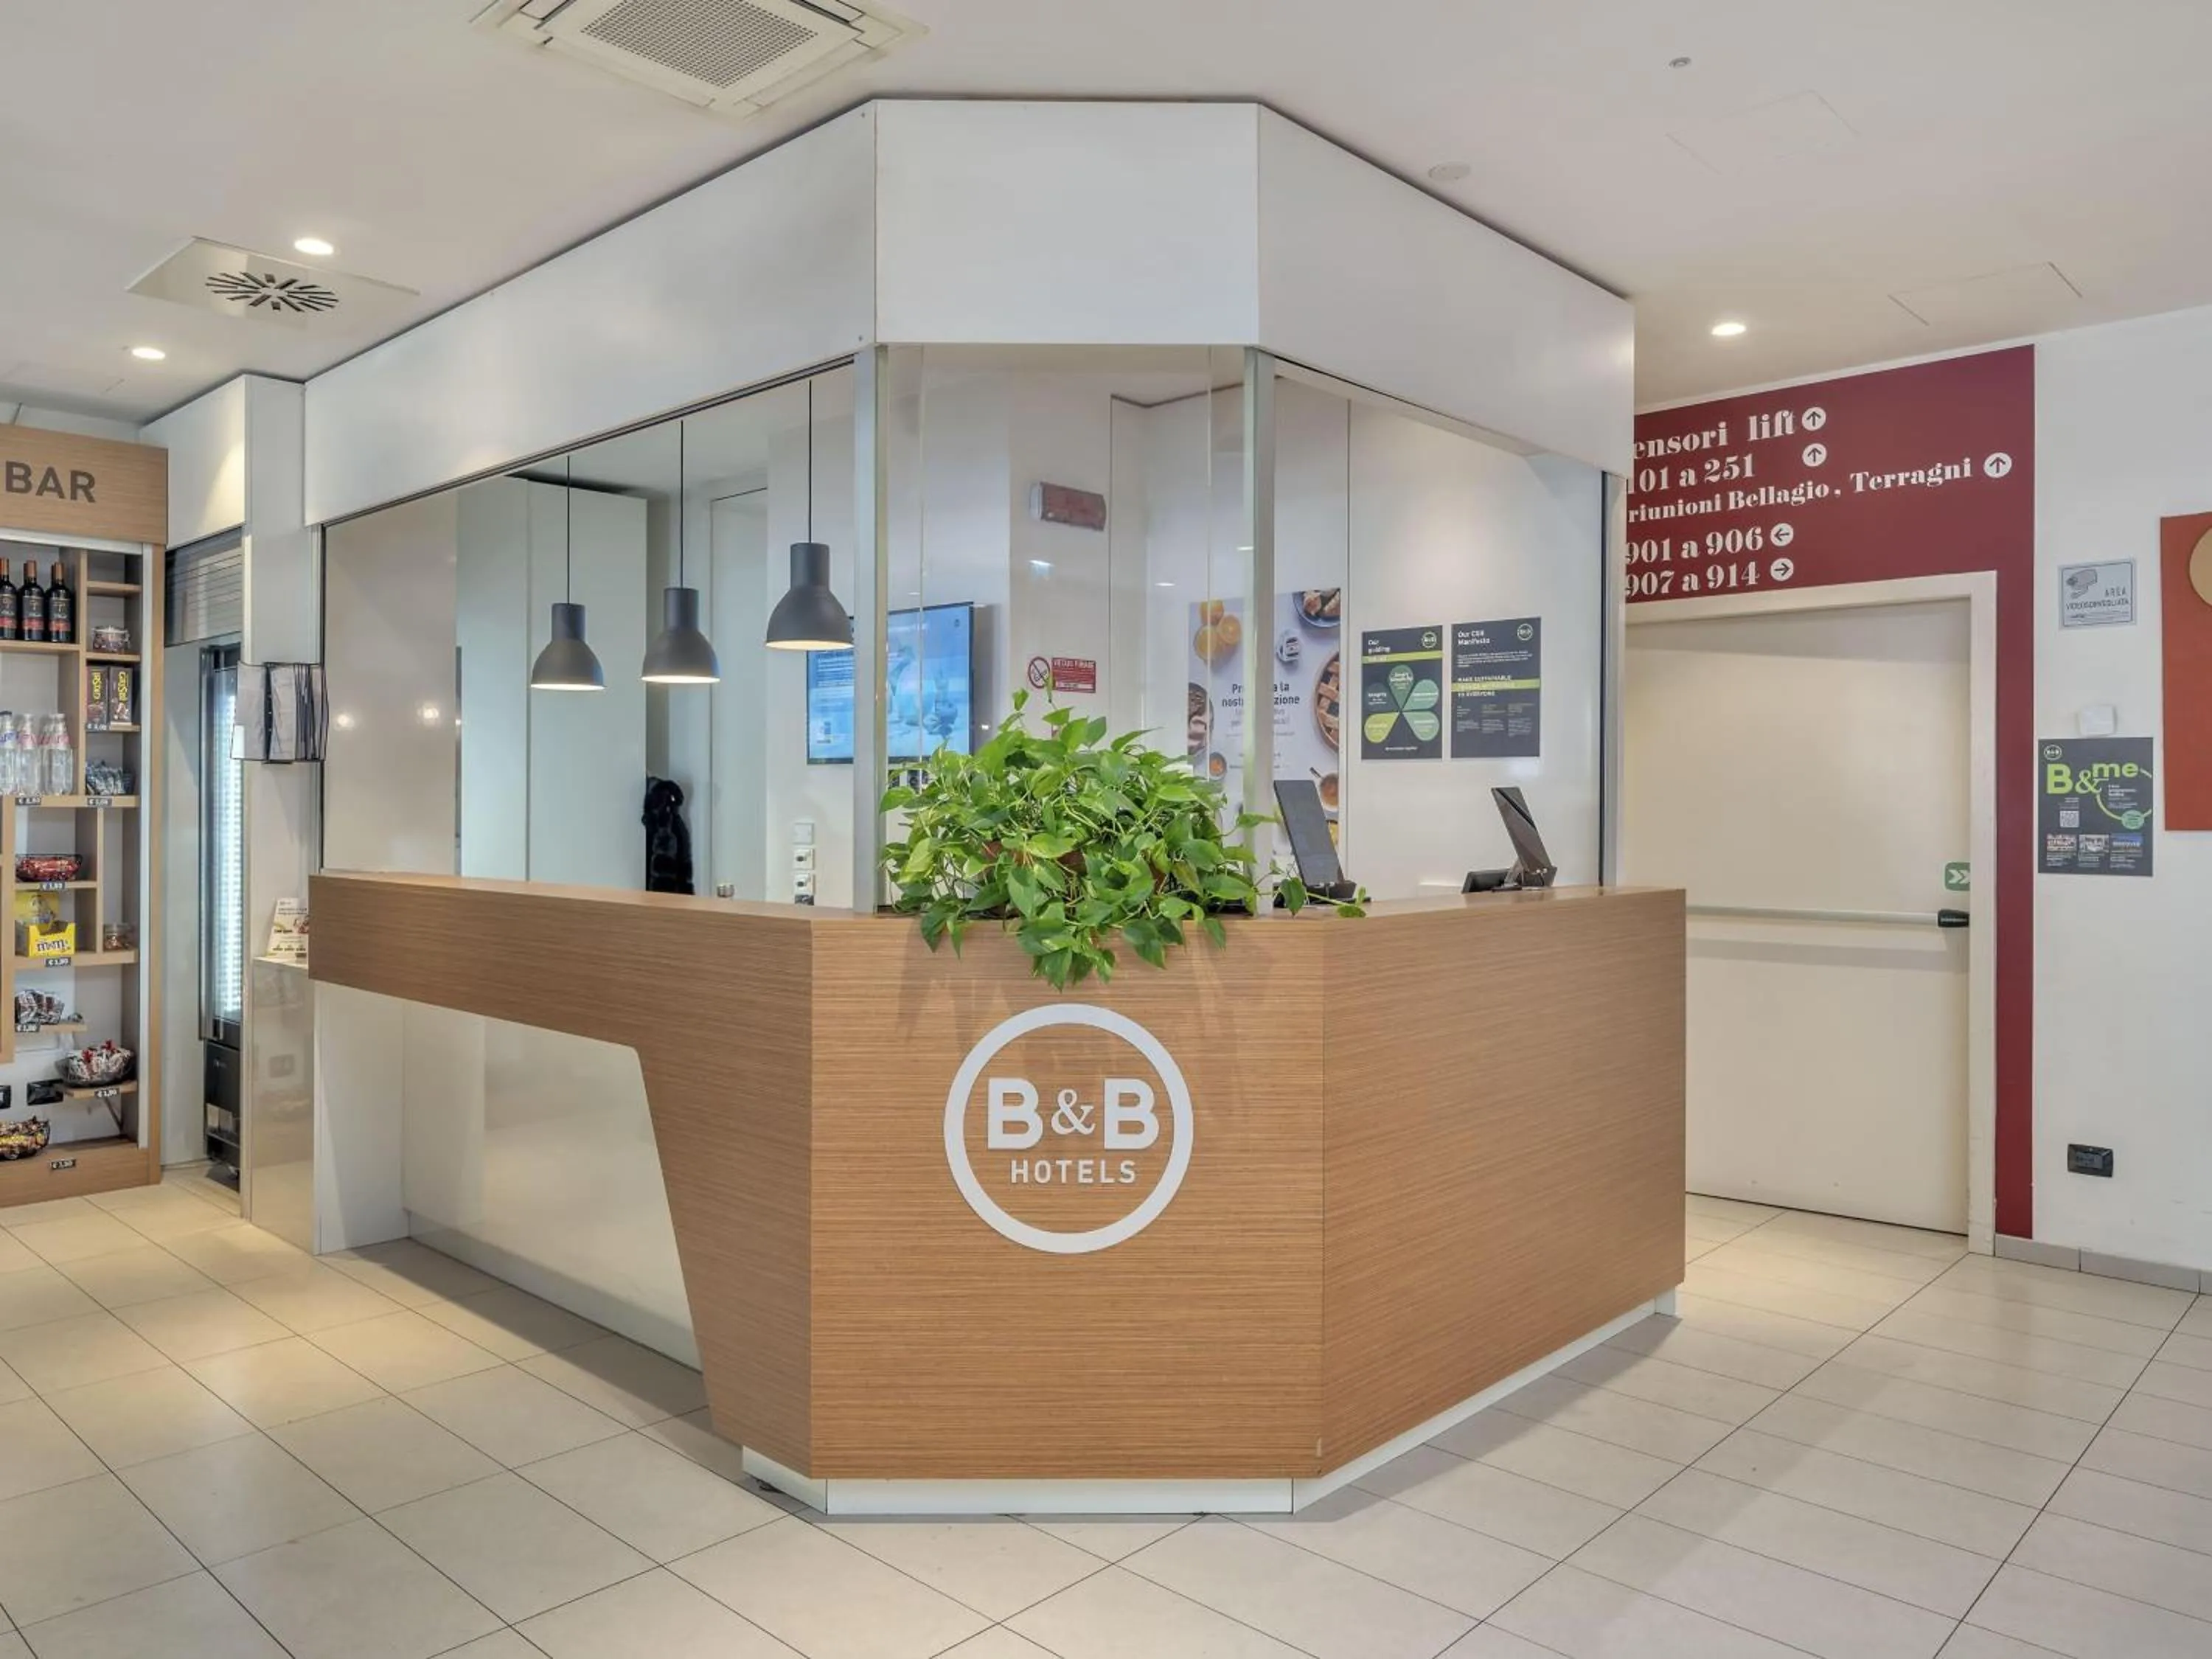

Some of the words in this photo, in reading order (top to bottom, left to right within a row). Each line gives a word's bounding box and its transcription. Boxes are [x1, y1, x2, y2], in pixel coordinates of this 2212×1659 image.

[1747, 410, 1795, 441] lift
[6, 461, 97, 503] BAR
[1680, 468, 1697, 487] a
[1705, 453, 1755, 483] 251
[1628, 493, 1722, 523] riunioni
[1850, 457, 1974, 493] Terragni
[1626, 538, 1671, 564] 901
[1680, 540, 1699, 558] a
[1705, 526, 1764, 555] 906
[1626, 571, 1674, 596] 907
[1682, 573, 1700, 591] a
[1706, 561, 1760, 589] 914
[1274, 695, 1300, 705] zione
[987, 1077, 1160, 1150] B&B
[1011, 1160, 1136, 1184] HOTELS
